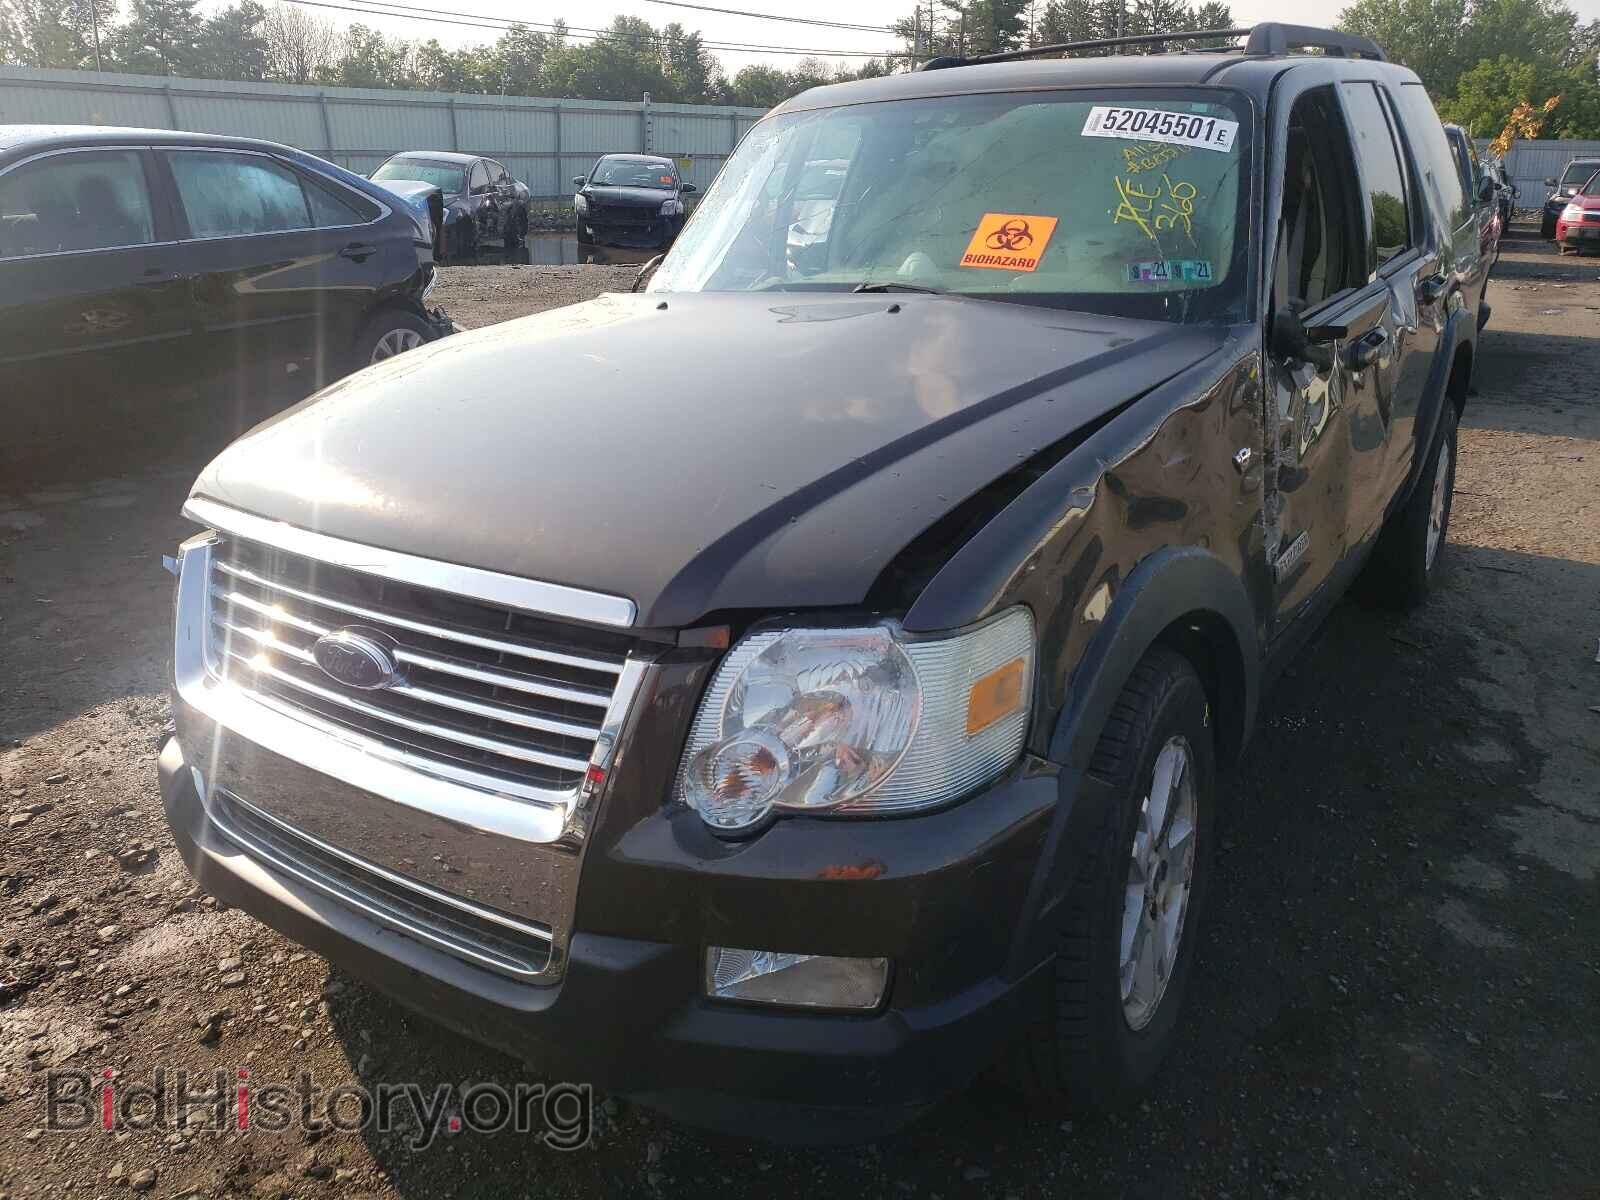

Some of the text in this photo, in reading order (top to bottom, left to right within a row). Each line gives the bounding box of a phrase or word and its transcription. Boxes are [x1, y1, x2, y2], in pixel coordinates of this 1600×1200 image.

[1103, 109, 1215, 142] 52045501
[1217, 129, 1228, 142] E
[964, 253, 1036, 269] BIOHAZARD
[1197, 262, 1210, 278] 21
